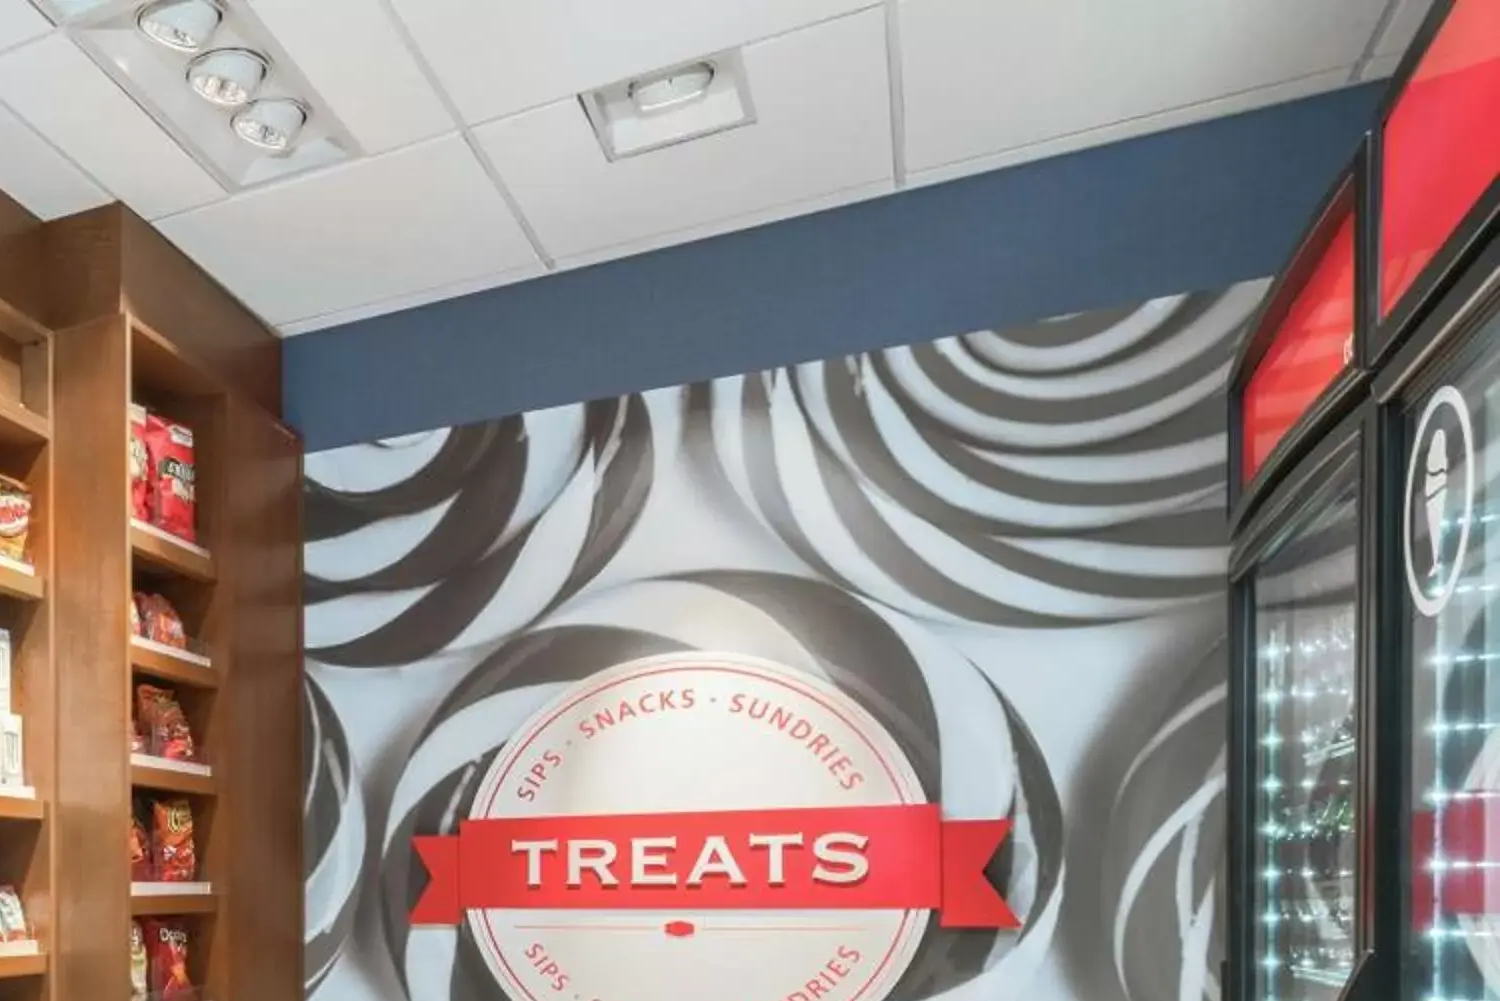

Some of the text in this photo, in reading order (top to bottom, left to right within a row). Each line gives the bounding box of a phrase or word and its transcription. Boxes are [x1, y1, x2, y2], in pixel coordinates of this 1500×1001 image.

[517, 688, 866, 802] SIPS SNACKS SUNDRIES
[511, 831, 870, 890] TREATS
[524, 942, 570, 992] SIPS
